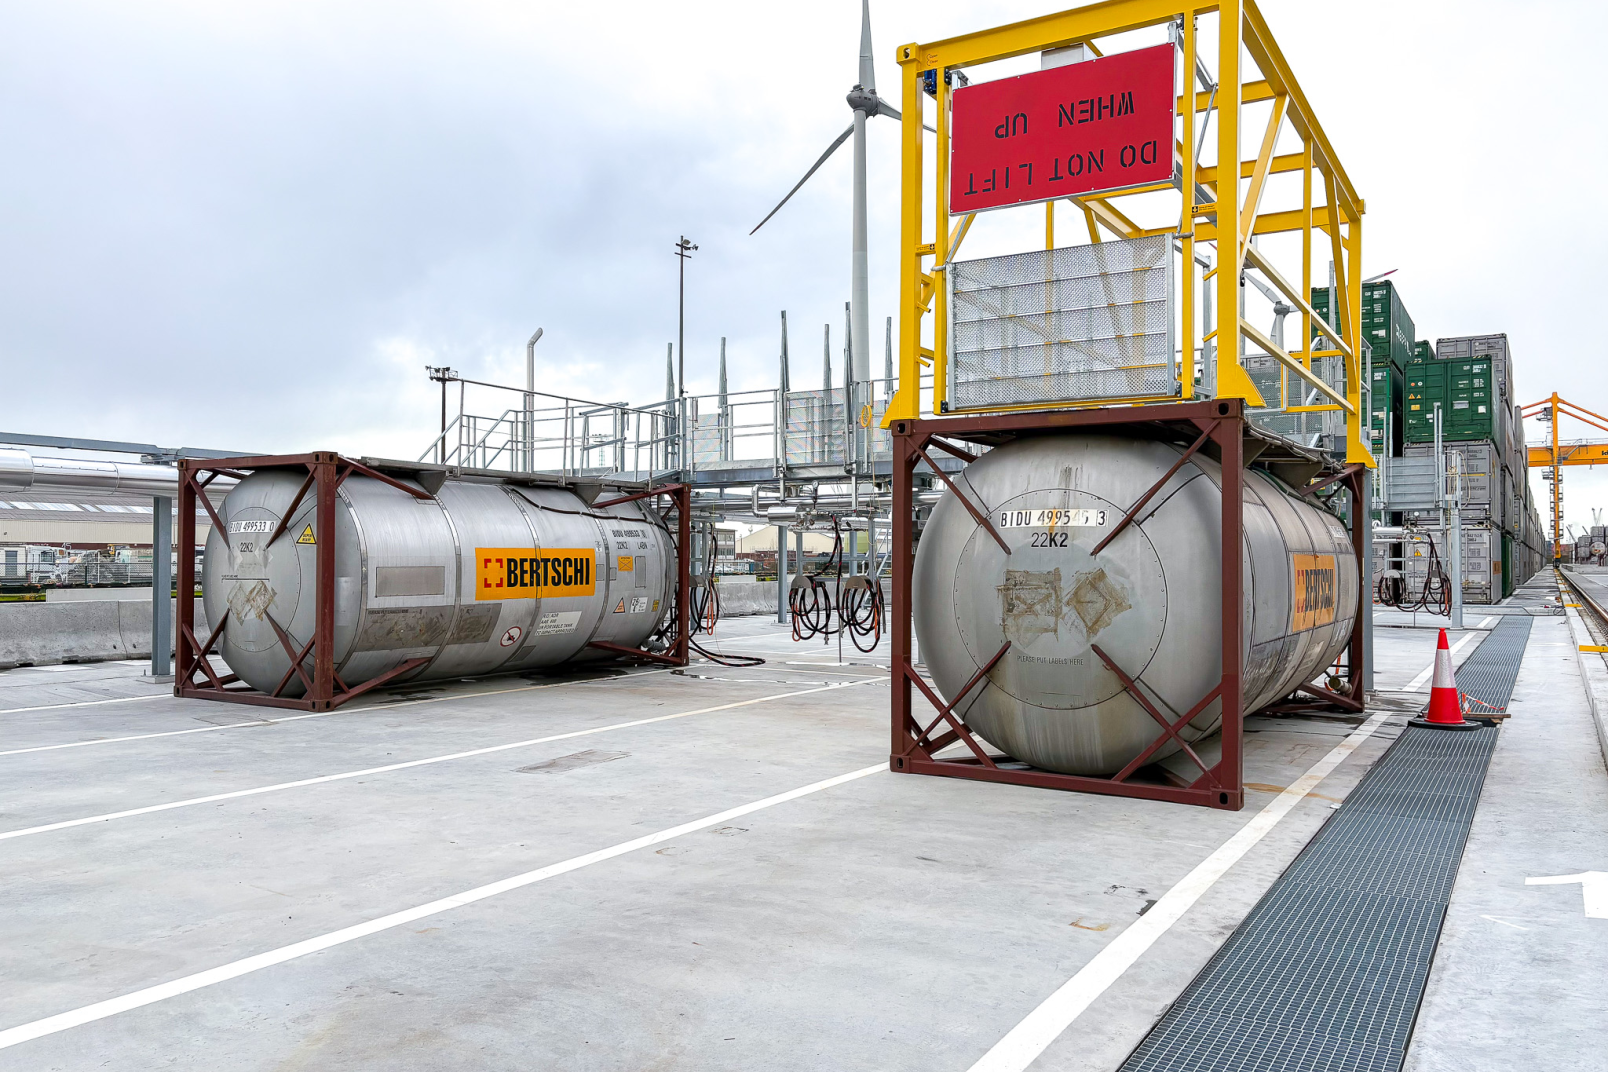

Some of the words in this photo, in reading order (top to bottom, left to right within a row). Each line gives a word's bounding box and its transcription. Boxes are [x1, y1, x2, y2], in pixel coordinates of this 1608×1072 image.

[1058, 91, 1135, 128] WHEN
[994, 112, 1028, 139] UP
[1049, 149, 1104, 182] NOT
[1120, 140, 1158, 168] DO
[964, 162, 1033, 196] LIFT
[1001, 510, 1032, 527] BIDU
[1037, 509, 1089, 525] 4995
[1097, 510, 1107, 526] 3
[240, 542, 254, 552] 22K2
[1030, 532, 1069, 548] 22K2
[507, 557, 590, 587] BERTSCHI
[1305, 568, 1333, 612] BERTSCHI
[1048, 657, 1068, 665] LABELS
[1069, 658, 1084, 666] HERE
